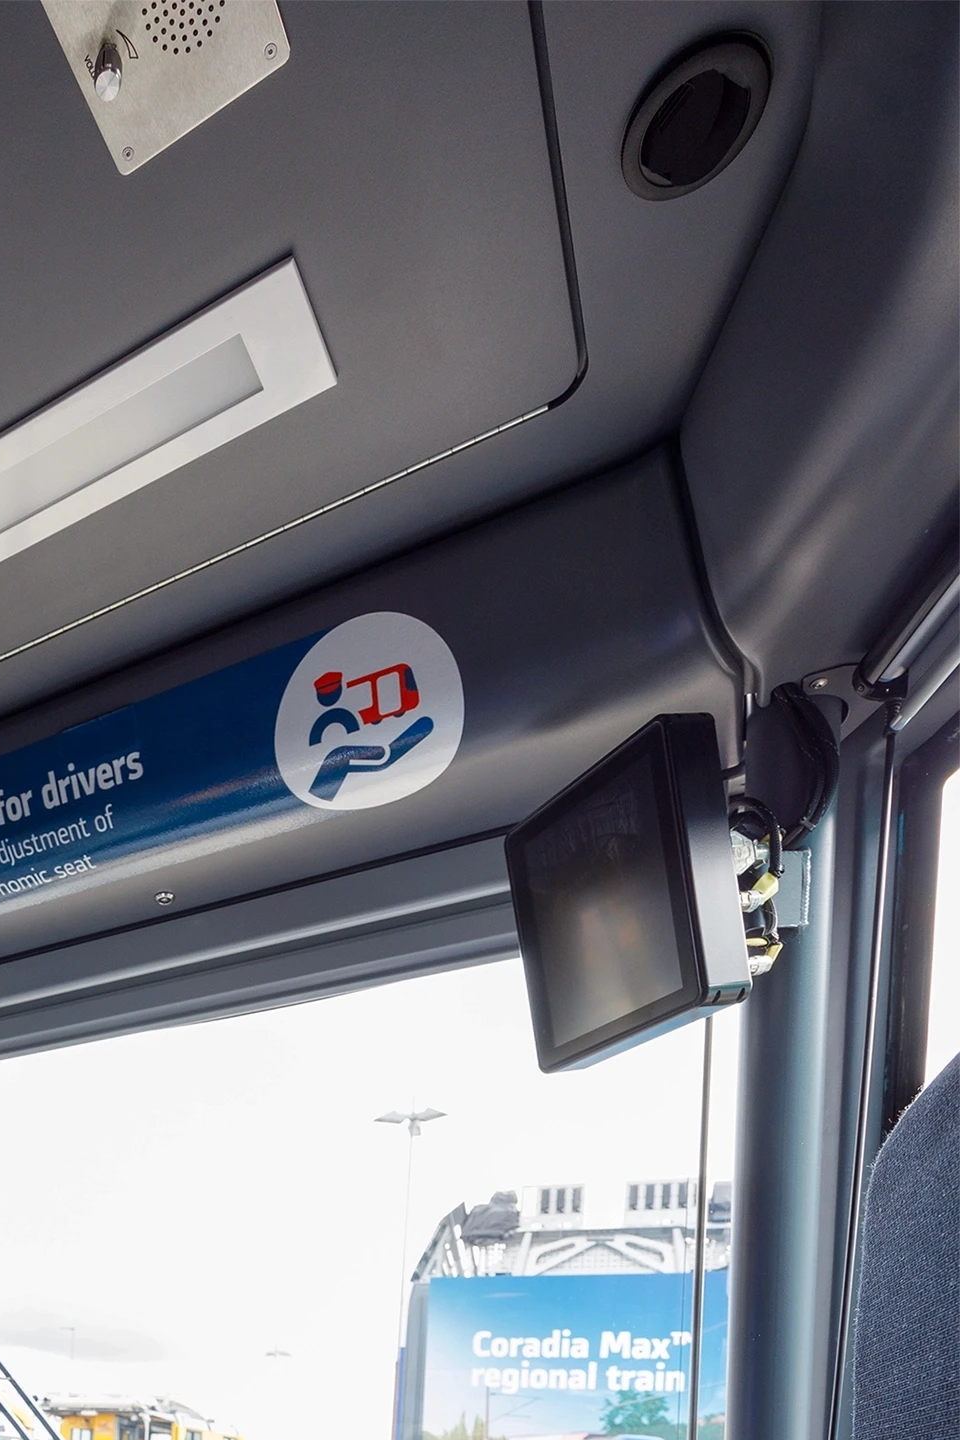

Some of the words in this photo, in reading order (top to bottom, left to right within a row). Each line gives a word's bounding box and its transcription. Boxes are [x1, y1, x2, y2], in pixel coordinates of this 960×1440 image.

[84, 54, 97, 80] VOLU
[41, 751, 144, 810] drivers
[94, 804, 114, 833] of
[54, 854, 97, 880] seat
[472, 1329, 589, 1358] Coradia
[471, 1360, 598, 1395] regional
[606, 1361, 686, 1392] train
